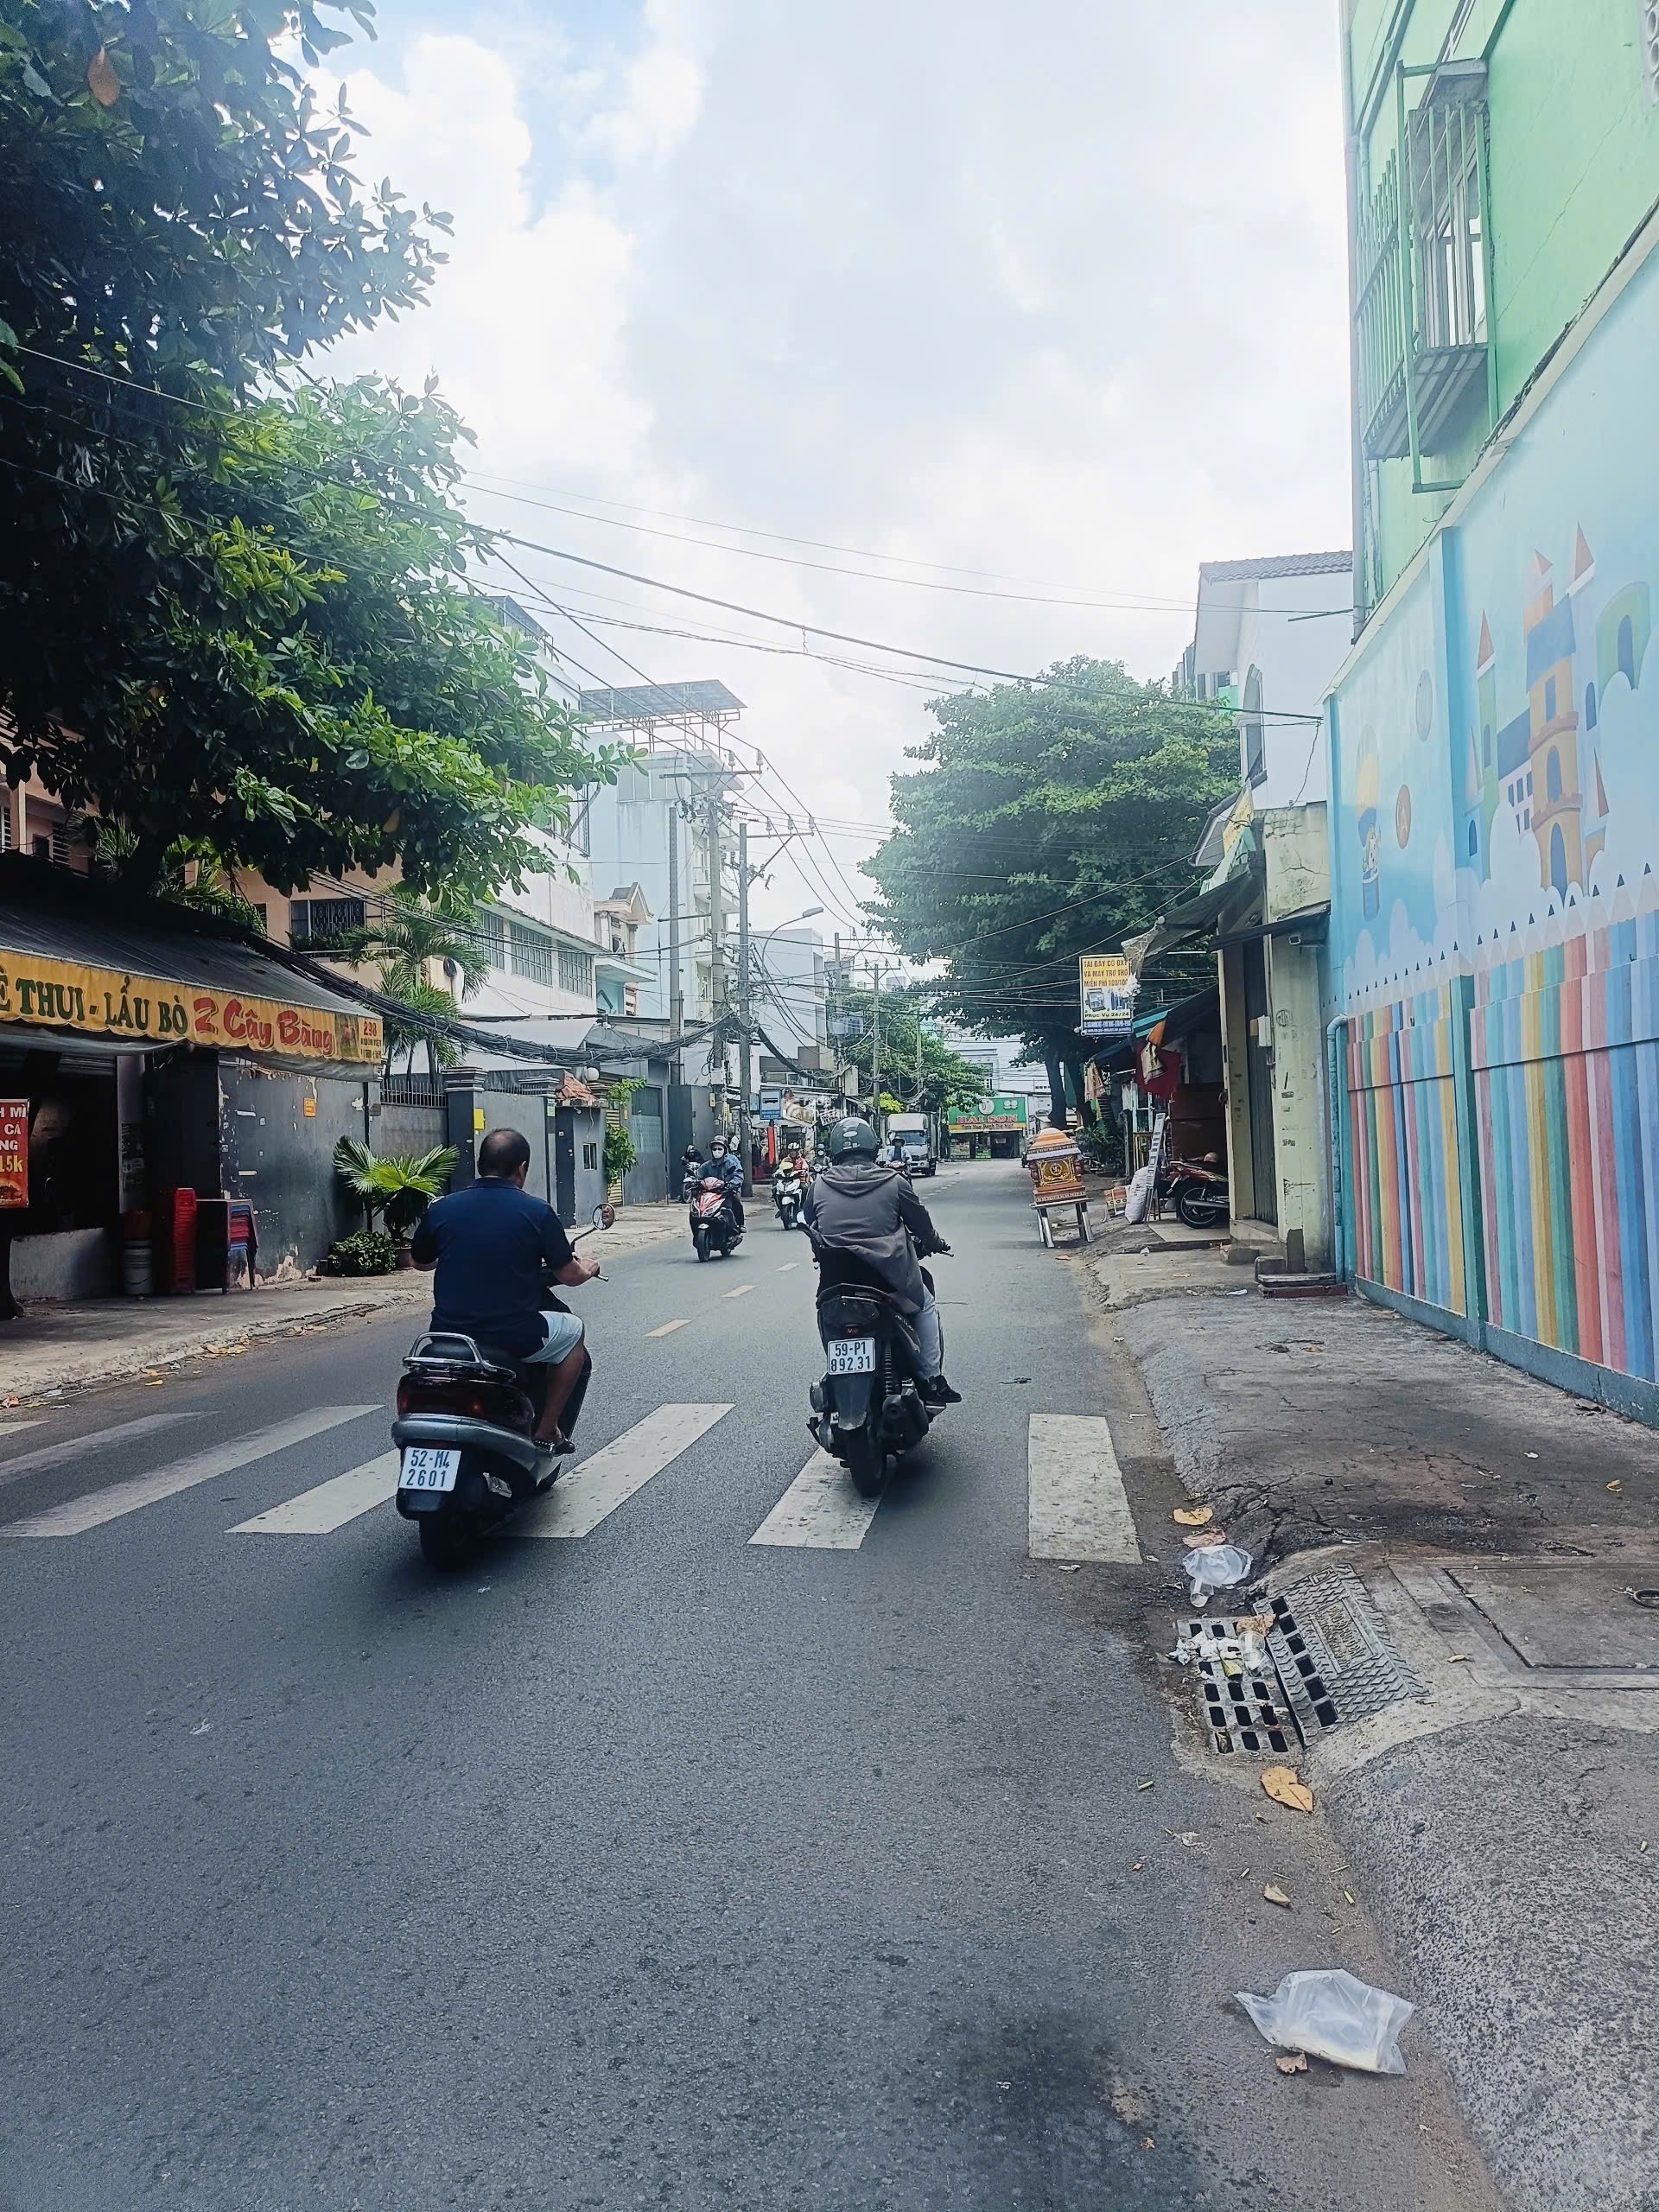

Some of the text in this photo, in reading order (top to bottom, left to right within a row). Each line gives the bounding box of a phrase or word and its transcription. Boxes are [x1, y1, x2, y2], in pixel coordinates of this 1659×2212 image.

[16, 978, 86, 1021] THUI
[104, 976, 149, 1031] LẨU
[158, 995, 188, 1035] BÒ
[193, 997, 217, 1034] 2
[223, 998, 273, 1049] Cây
[276, 1009, 334, 1057] Bàng
[957, 1112, 1018, 1124] HẢI SƠN
[4, 1121, 22, 1135] CÁ
[835, 1341, 866, 1357] 59-P1
[830, 1355, 870, 1371] 892.31
[406, 1468, 446, 1487] 2601
